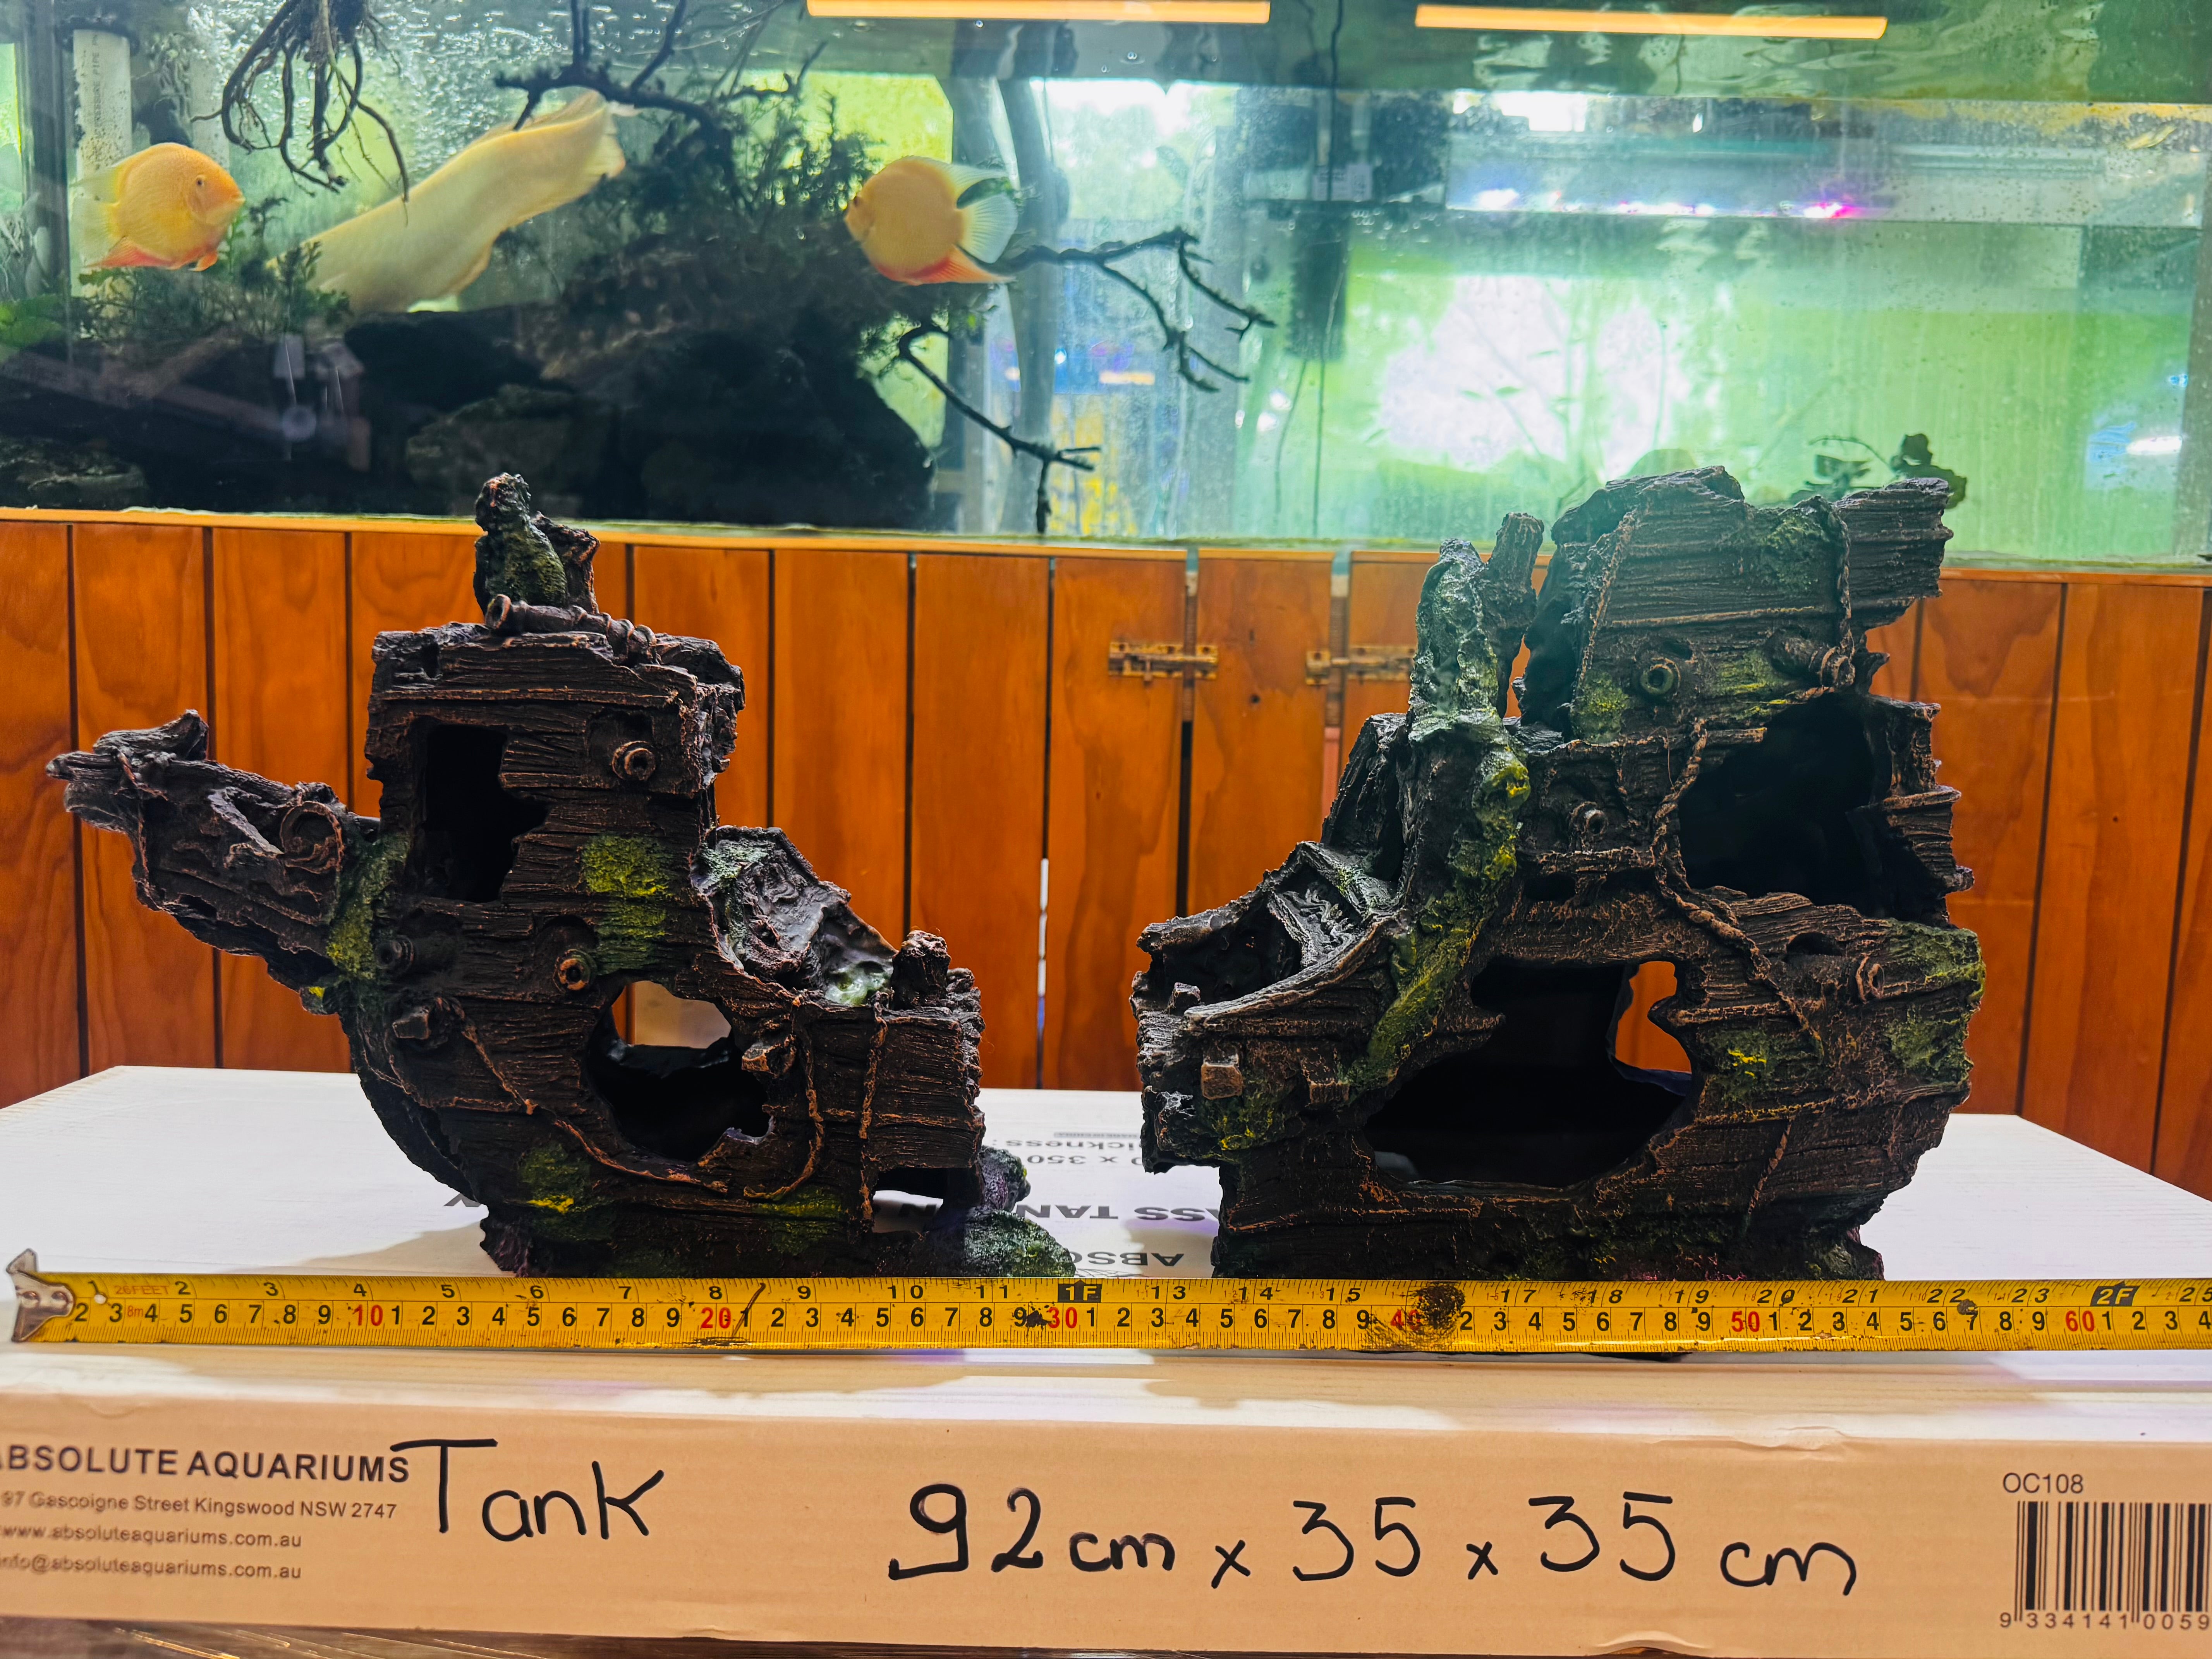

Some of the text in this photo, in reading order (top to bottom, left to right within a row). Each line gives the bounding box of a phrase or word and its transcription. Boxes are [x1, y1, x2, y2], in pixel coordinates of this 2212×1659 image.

[993, 1139, 1142, 1151] ickness:
[1027, 1154, 1087, 1164] 350
[115, 1285, 169, 1294] 26FEET
[175, 1281, 191, 1295] 2
[263, 1282, 279, 1297] 3
[353, 1283, 367, 1297] 4
[441, 1284, 455, 1298] 5
[529, 1285, 544, 1299] 6
[618, 1286, 632, 1300] 7
[709, 1286, 723, 1300] 8
[797, 1286, 812, 1300] 9
[888, 1285, 924, 1299] 10
[1065, 1285, 1099, 1301] 1F
[1151, 1286, 1186, 1300] 13
[1239, 1286, 1273, 1301] 14
[1326, 1287, 1361, 1302] 15
[1501, 1289, 1536, 1303] 17
[1588, 1289, 1623, 1304] 18
[1676, 1289, 1709, 1304] 19
[1757, 1289, 1795, 1304] 20
[1842, 1289, 1879, 1303] 21
[1927, 1288, 1966, 1303] 22
[2011, 1288, 2050, 1303] 23
[2096, 1288, 2133, 1305] 2F
[74, 1302, 89, 1322] 2
[110, 1303, 123, 1322] 3
[127, 1305, 144, 1317] 8m
[144, 1304, 158, 1322] 4
[179, 1304, 193, 1323] 5
[214, 1304, 228, 1324] 6
[249, 1304, 262, 1324] 7
[283, 1304, 297, 1324] 8
[318, 1305, 332, 1325] 9
[352, 1304, 383, 1326] 10
[391, 1305, 400, 1325] 1
[422, 1305, 436, 1325] 2
[457, 1306, 470, 1326] 3
[492, 1307, 505, 1326] 4
[527, 1307, 540, 1327] 5
[562, 1307, 577, 1327] 6
[596, 1307, 611, 1327] 7
[632, 1307, 645, 1328] 8
[666, 1307, 680, 1328] 9
[700, 1307, 732, 1329] 20
[771, 1307, 785, 1327] 2
[806, 1307, 819, 1327] 3
[841, 1307, 855, 1327] 4
[876, 1307, 890, 1327] 5
[911, 1307, 924, 1327] 6
[945, 1307, 958, 1327] 7
[980, 1307, 993, 1327] 8
[1014, 1307, 1027, 1328] 9
[1047, 1307, 1078, 1329] 30
[1086, 1307, 1096, 1327] 1
[1117, 1307, 1130, 1327] 2
[1151, 1307, 1164, 1328] 3
[1185, 1308, 1199, 1328] 4
[1220, 1308, 1234, 1328] 5
[1254, 1309, 1268, 1328] 6
[1288, 1309, 1301, 1329] 7
[1322, 1309, 1336, 1329] 8
[1356, 1309, 1370, 1329] 9
[1460, 1311, 1473, 1330] 2
[1494, 1311, 1507, 1331] 3
[1528, 1312, 1542, 1331] 4
[1563, 1312, 1576, 1331] 5
[1596, 1312, 1610, 1331] 6
[1630, 1312, 1643, 1331] 7
[1664, 1312, 1677, 1331] 8
[1698, 1312, 1711, 1331] 9
[1731, 1311, 1760, 1332] 50
[1768, 1312, 1778, 1331] 1
[1799, 1312, 1812, 1331] 2
[1832, 1312, 1845, 1331] 3
[1867, 1312, 1879, 1331] 4
[1900, 1312, 1913, 1331] 5
[1933, 1311, 1946, 1331] 6
[1965, 1310, 1978, 1331] 7
[1999, 1311, 2012, 1331] 8
[2032, 1311, 2045, 1331] 9
[2065, 1310, 2095, 1332] 60
[2102, 1311, 2111, 1330] 1
[2131, 1311, 2145, 1330] 2
[2164, 1310, 2178, 1330] 3
[2198, 1310, 2211, 1330] 4
[0, 1445, 410, 1483] BSOLUTE AQUARIUMS
[390, 1437, 665, 1542] Tank
[2002, 1472, 2084, 1494] OC108
[29, 1491, 129, 1513] Gascoigne
[135, 1494, 189, 1513] Street
[195, 1496, 294, 1518] Kingswood
[301, 1501, 346, 1518] NSW
[352, 1503, 397, 1520] 2747
[0, 1525, 302, 1548] www.absoluteaquariums.com.au
[1211, 1539, 1251, 1589] x
[1292, 1496, 1421, 1582] 35
[1466, 1541, 1499, 1580] x
[1528, 1491, 1676, 1582] 35
[1719, 1541, 1857, 1596] cm
